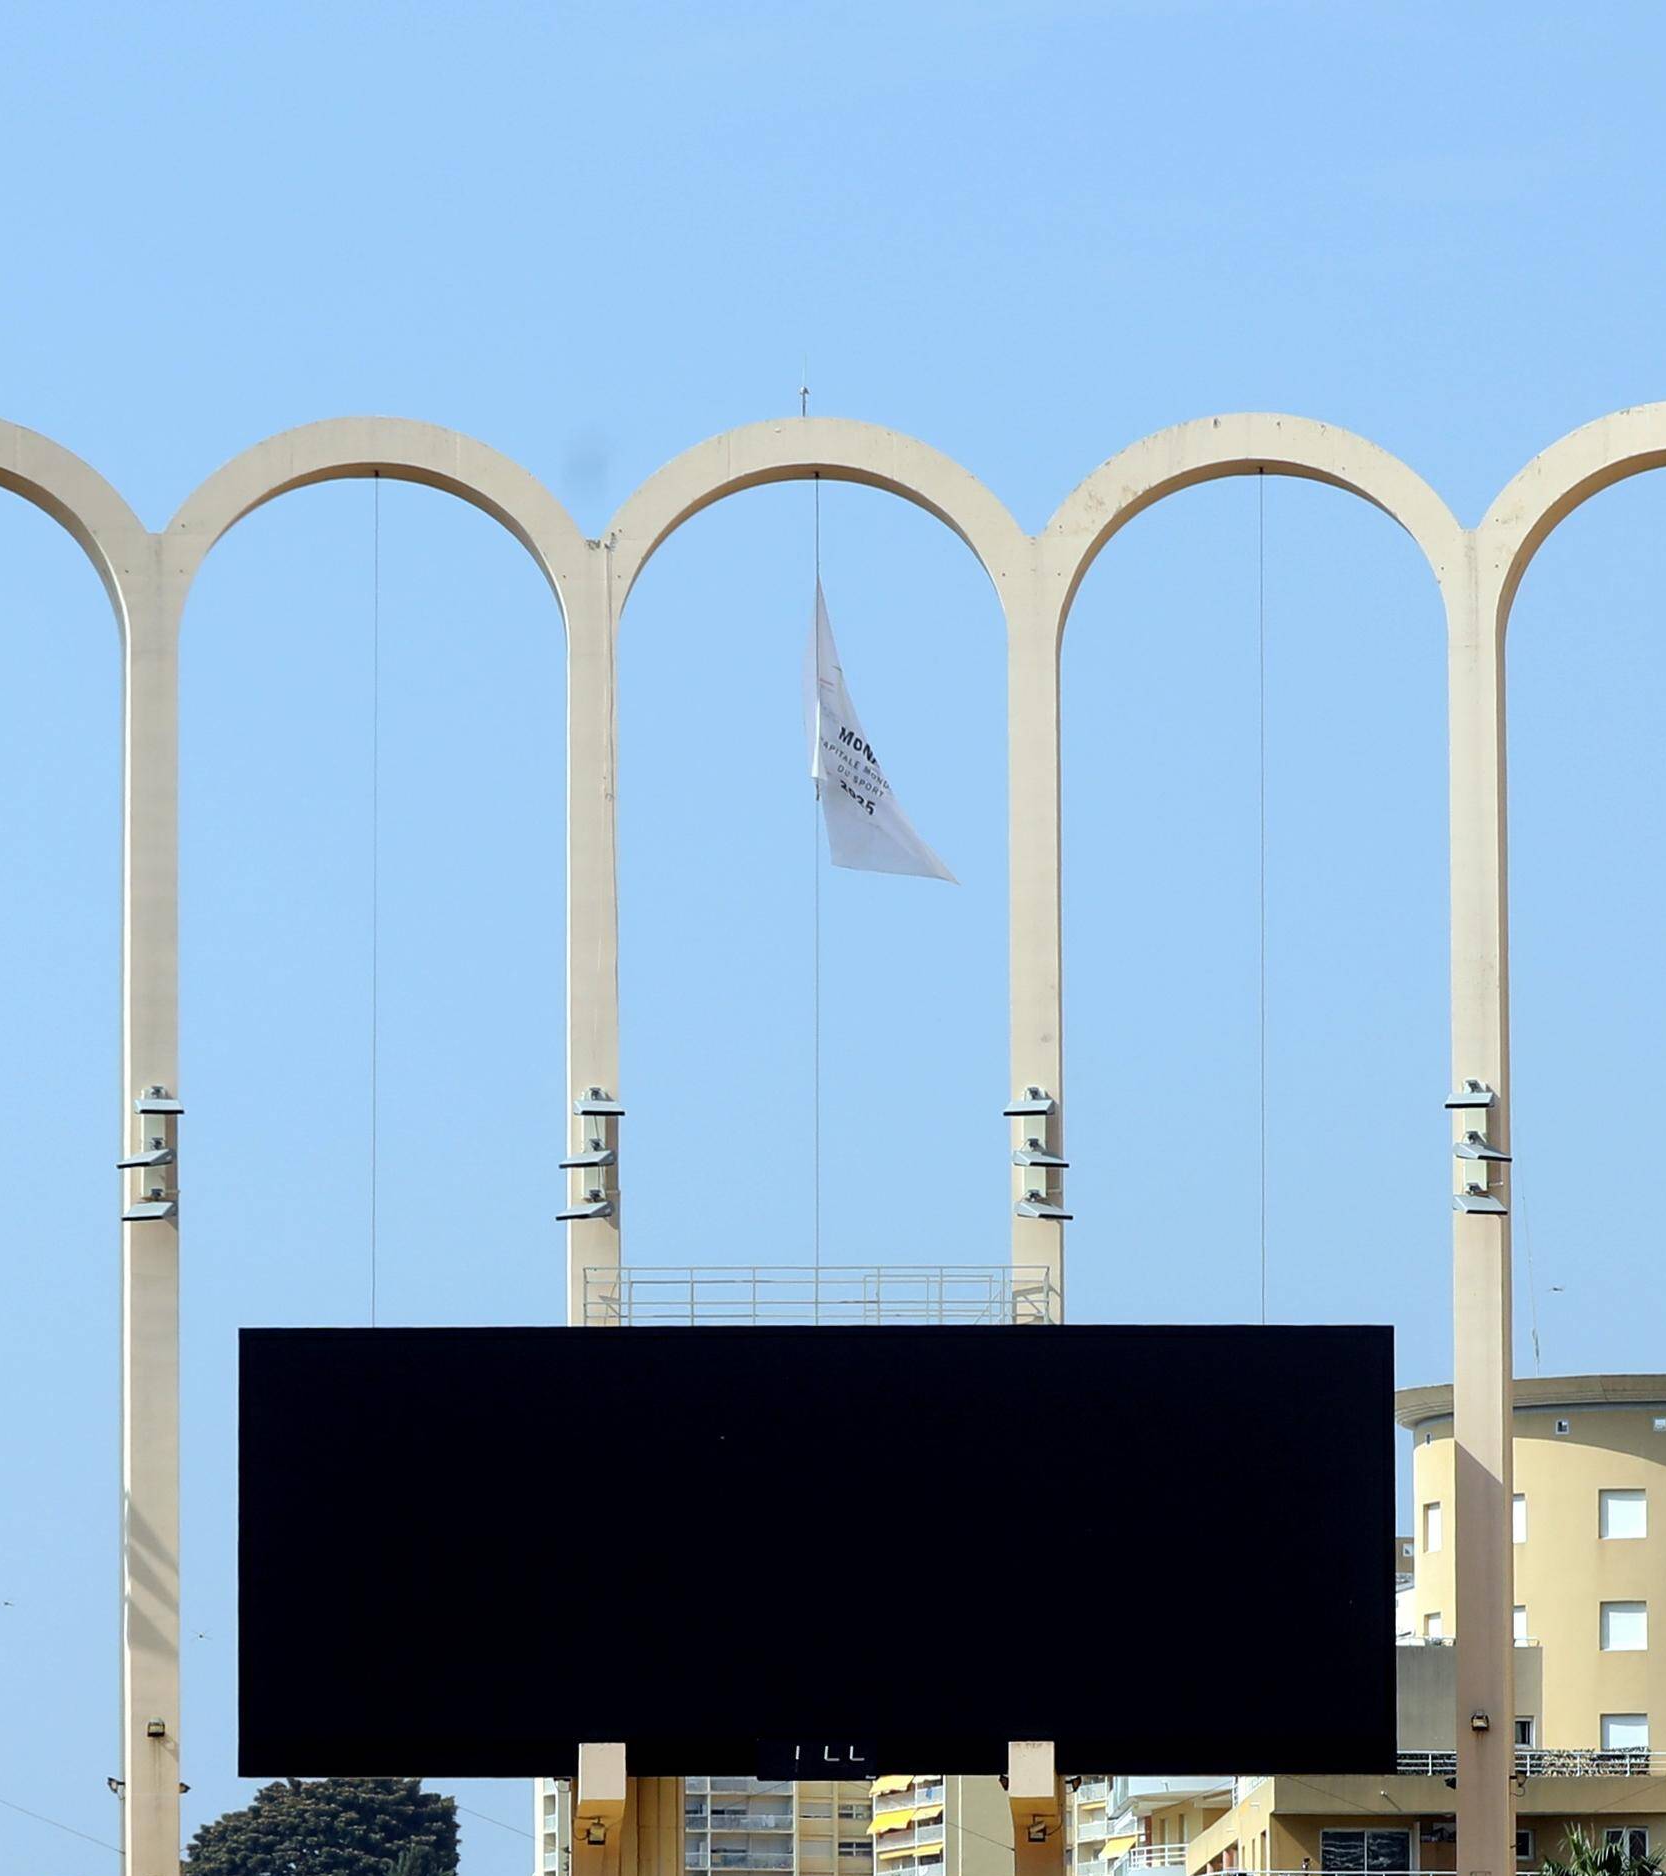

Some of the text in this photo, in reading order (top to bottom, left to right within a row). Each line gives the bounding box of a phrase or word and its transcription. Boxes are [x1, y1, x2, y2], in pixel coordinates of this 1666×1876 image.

[821, 737, 860, 769] APITALE
[837, 764, 884, 797] DU SPORT
[840, 780, 876, 815] 2025
